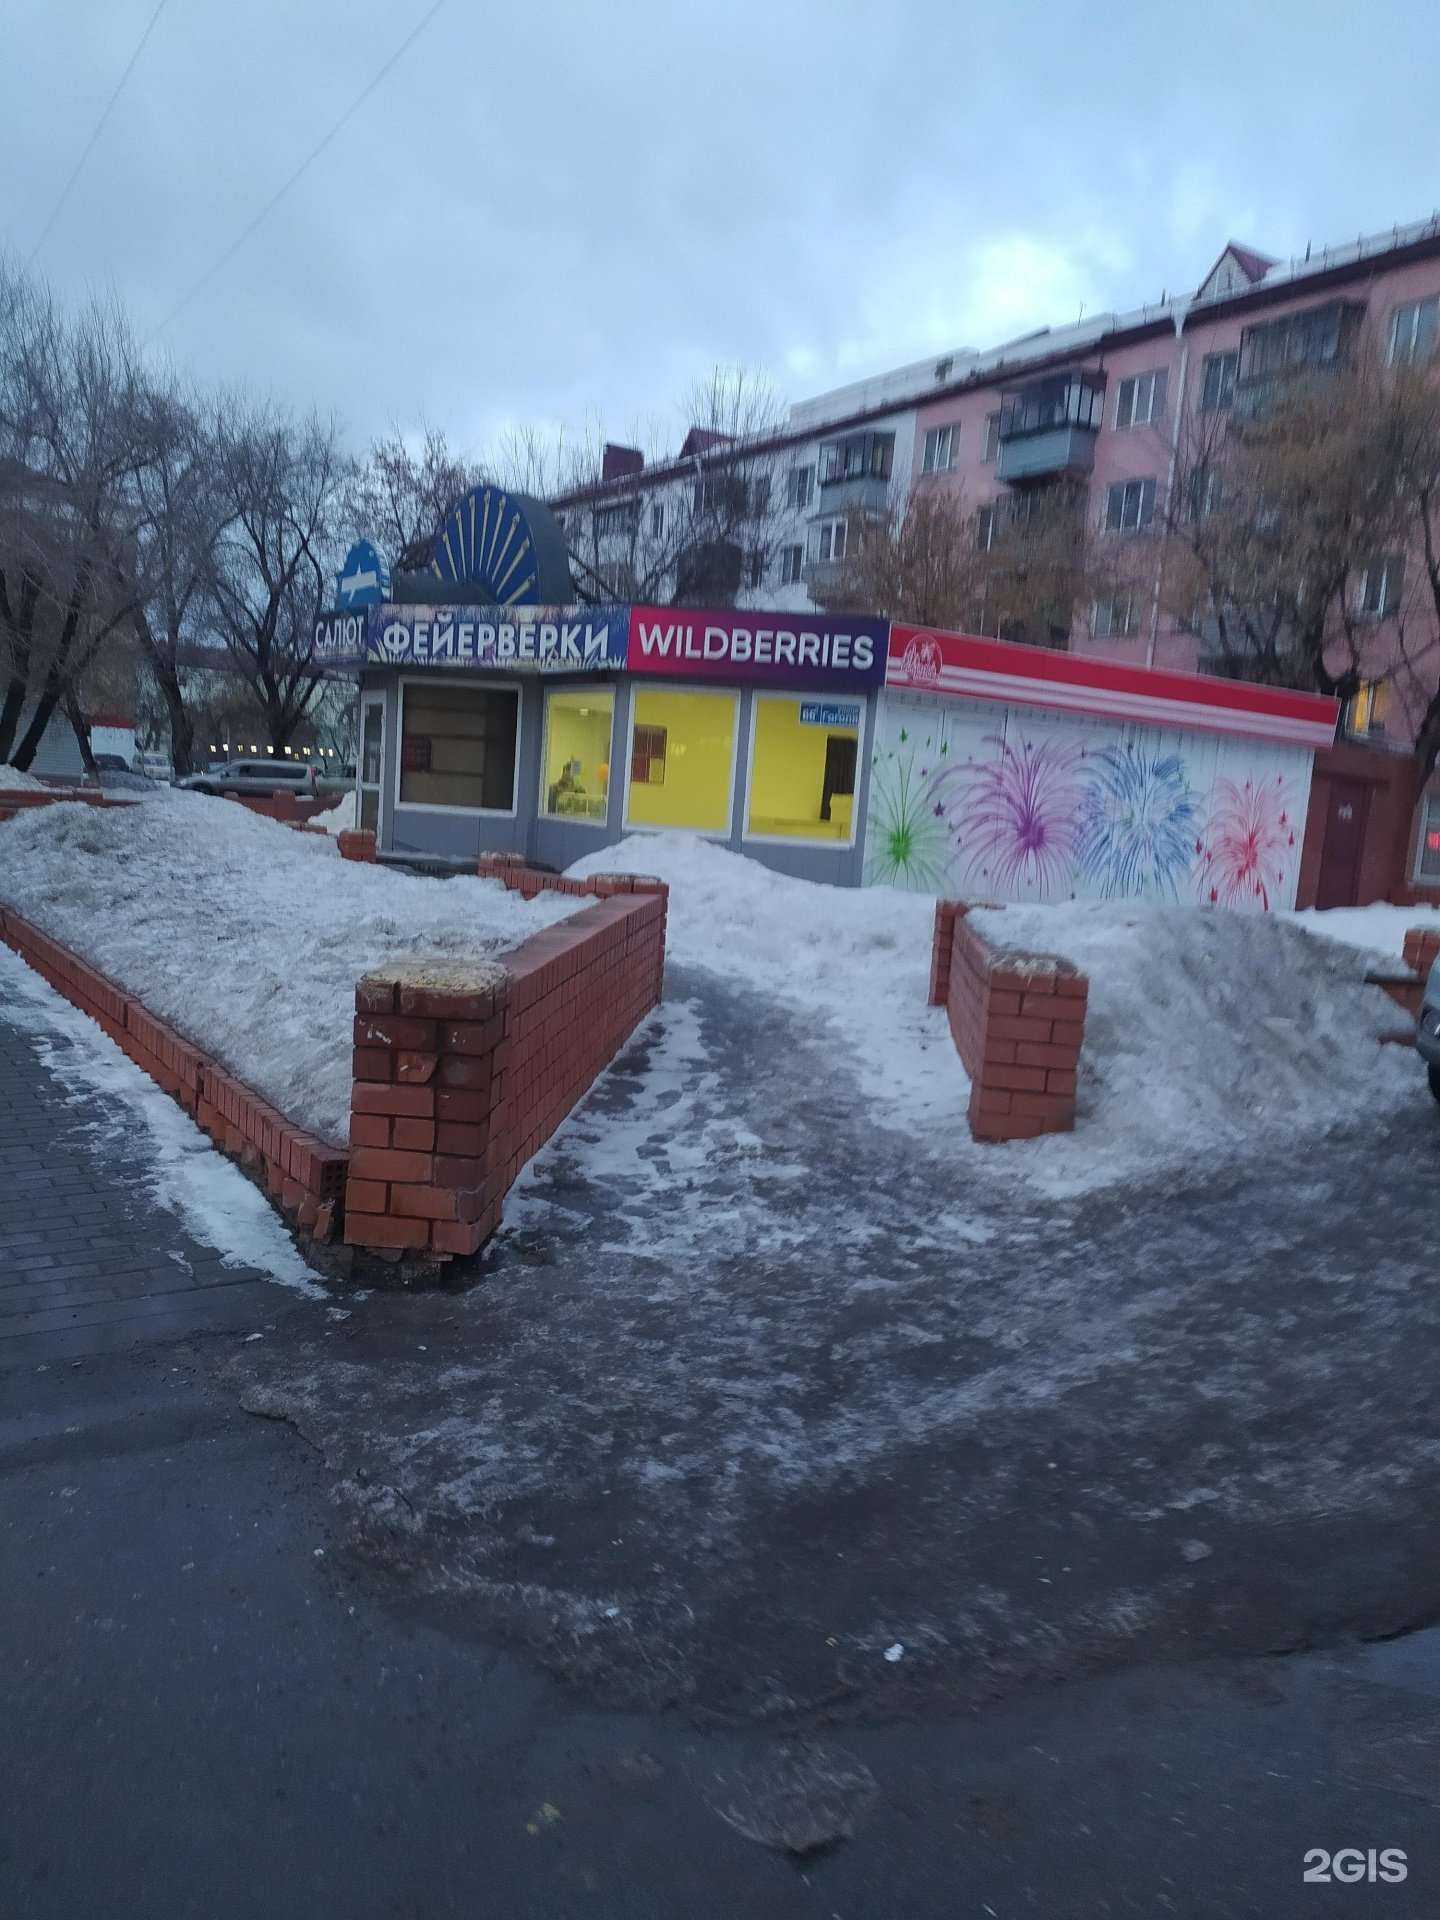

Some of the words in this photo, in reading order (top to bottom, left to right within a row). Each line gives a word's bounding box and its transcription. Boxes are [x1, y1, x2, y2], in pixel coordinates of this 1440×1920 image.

[315, 616, 364, 648] САЛЮТ
[383, 611, 610, 658] ФЕЙЕРВЕРКИ
[638, 623, 874, 670] WILDBERRIES
